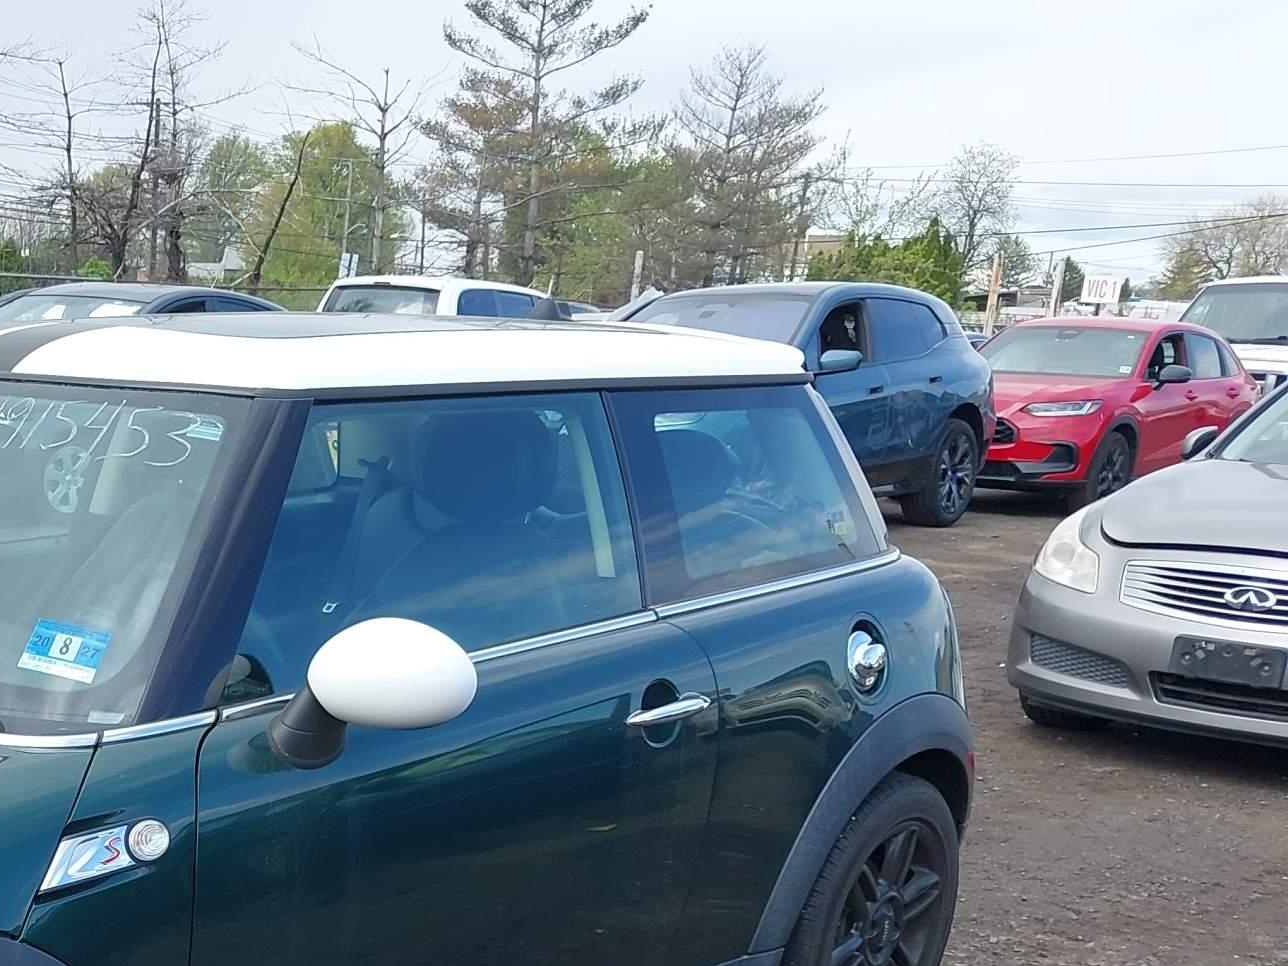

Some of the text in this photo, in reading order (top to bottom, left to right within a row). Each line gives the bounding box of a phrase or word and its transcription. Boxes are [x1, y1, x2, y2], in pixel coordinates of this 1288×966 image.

[1088, 279, 1118, 300] VIC 1
[32, 634, 101, 659] 20 8 27
[99, 836, 122, 866] S
